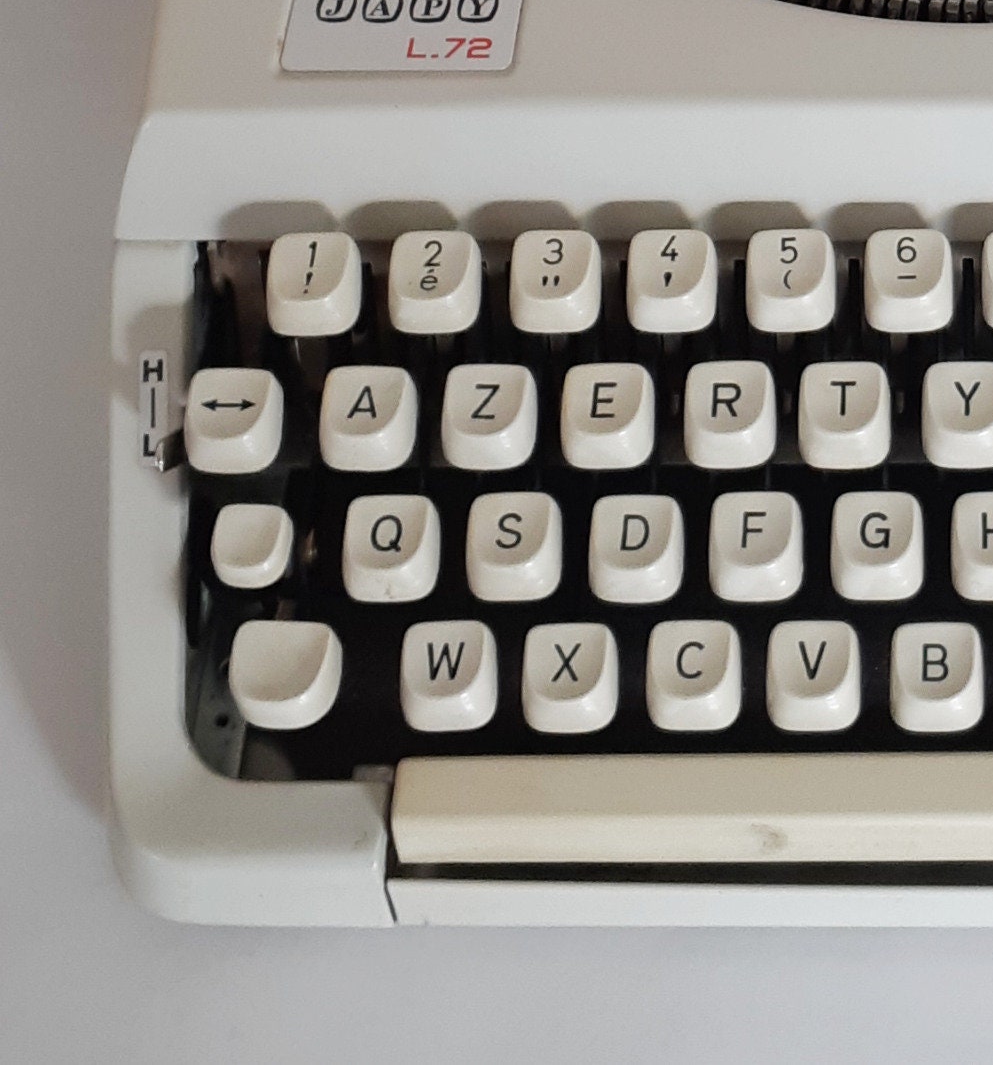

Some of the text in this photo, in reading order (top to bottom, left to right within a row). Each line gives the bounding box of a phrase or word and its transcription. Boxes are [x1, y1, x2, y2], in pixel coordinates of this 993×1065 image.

[407, 38, 492, 59] L.72
[309, 241, 318, 268] 1
[423, 240, 443, 268] 2
[542, 238, 564, 266] 3
[660, 235, 679, 262] 4
[780, 236, 799, 265] 5
[896, 236, 917, 264] 6
[303, 271, 314, 294] !
[419, 268, 439, 292] é
[143, 359, 163, 382] H
[346, 385, 377, 420] A
[470, 383, 501, 420] Z
[589, 381, 618, 419] E
[711, 382, 742, 418] R
[830, 380, 857, 417] T
[954, 381, 981, 417] Y
[143, 433, 157, 457] L
[370, 514, 403, 553] Q
[495, 512, 523, 550] S
[619, 514, 650, 552] D
[740, 511, 767, 549] F
[859, 512, 891, 549] G
[427, 641, 465, 681] W
[551, 643, 582, 683] X
[676, 641, 705, 680] C
[798, 640, 827, 681] V
[921, 643, 950, 683] B
